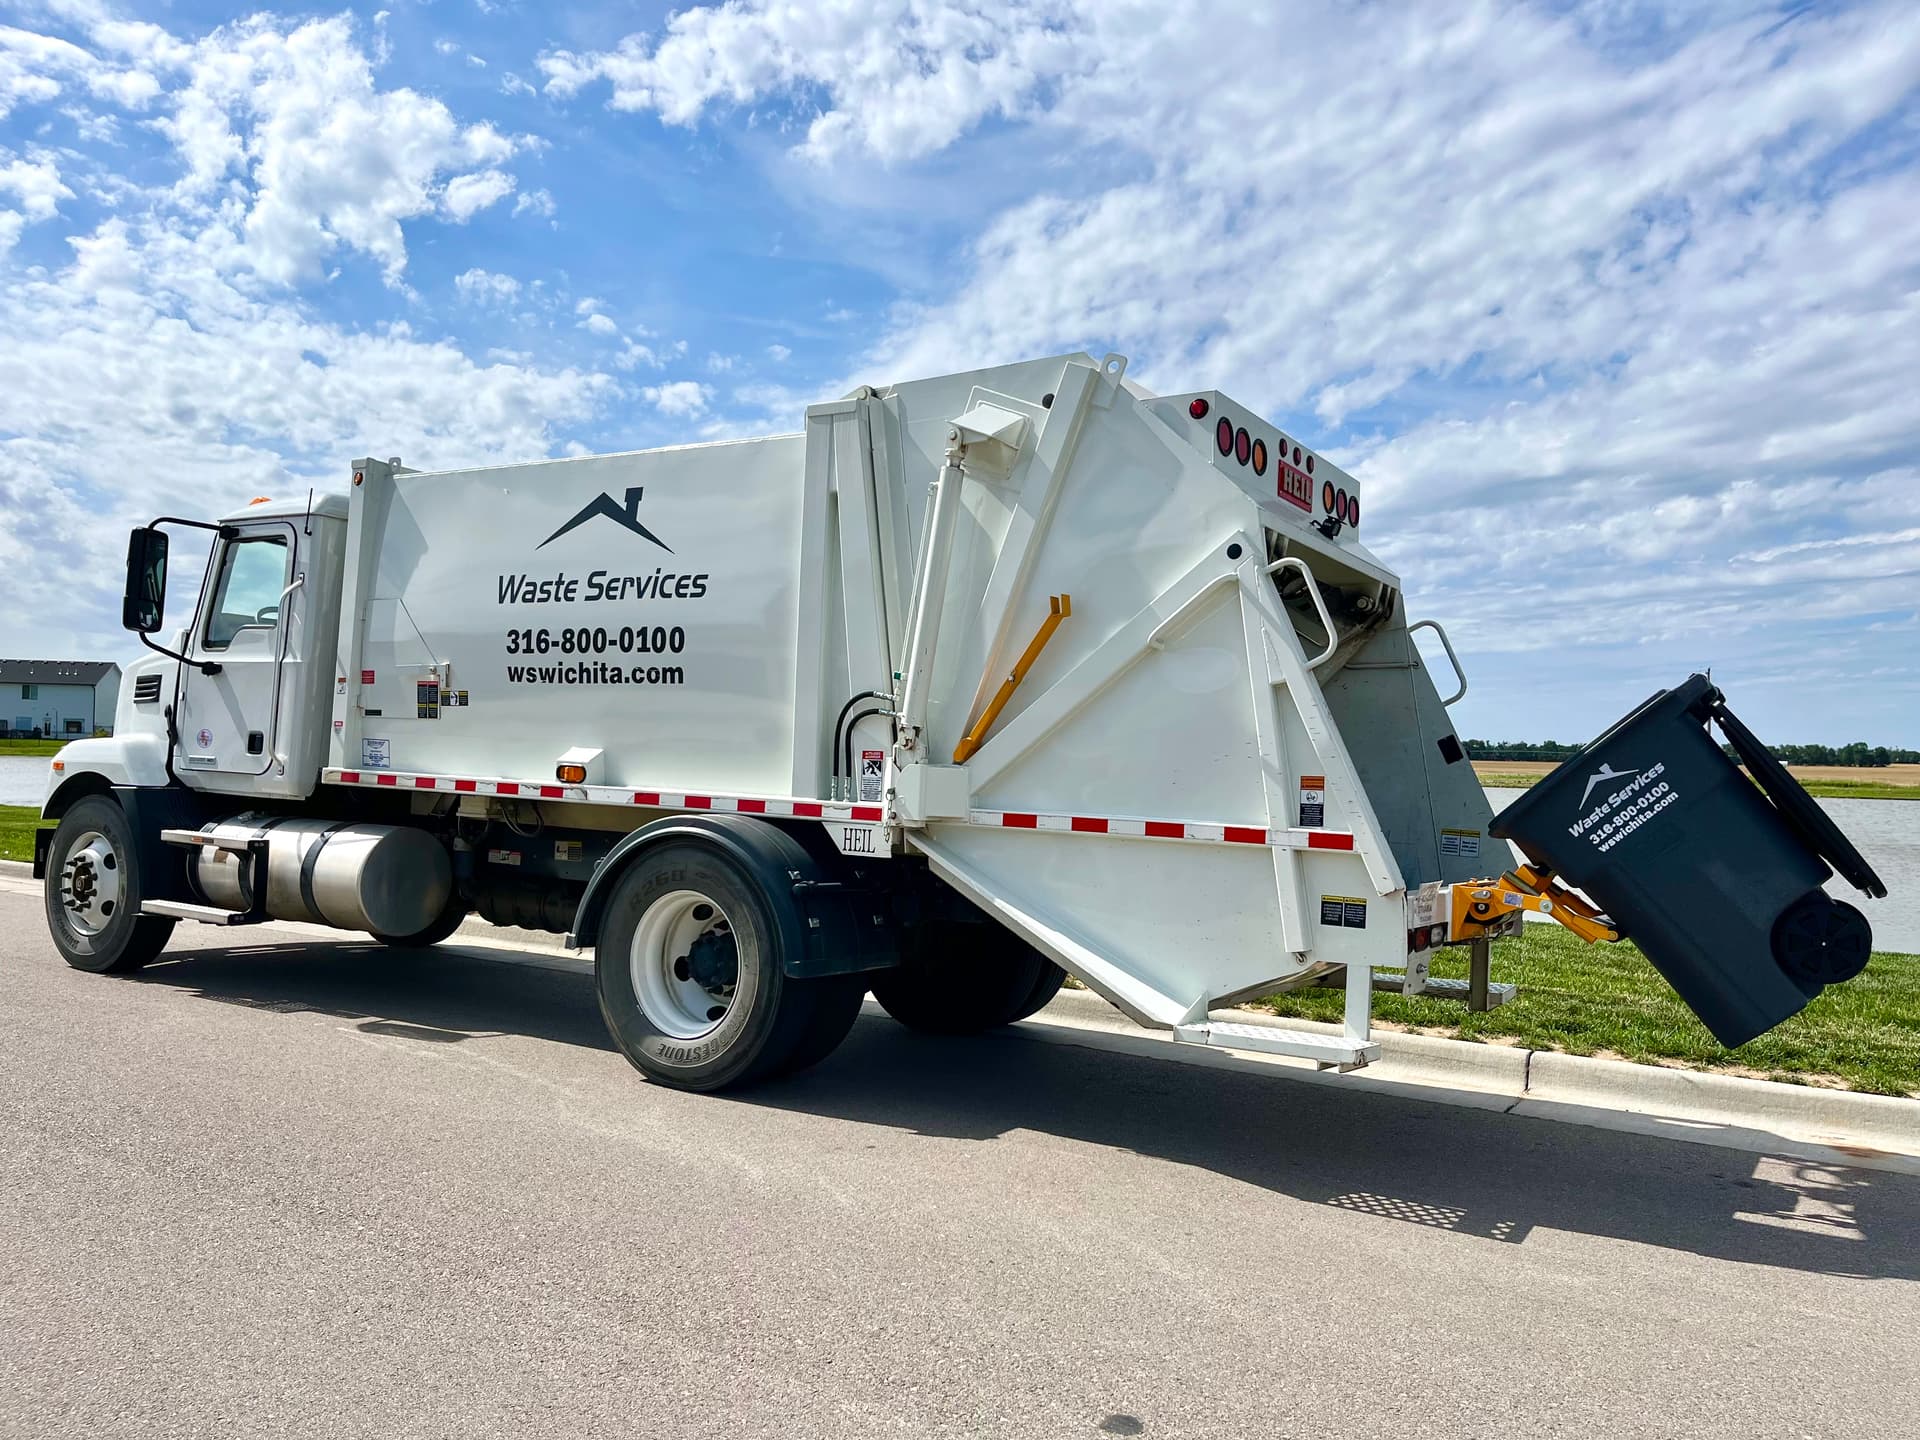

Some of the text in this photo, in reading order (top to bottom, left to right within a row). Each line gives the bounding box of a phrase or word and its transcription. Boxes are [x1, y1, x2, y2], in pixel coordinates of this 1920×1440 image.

[1284, 467, 1312, 504] HEIL
[498, 568, 709, 604] Waste Services
[506, 626, 685, 654] 316-800-0100
[507, 661, 684, 684] wswichita.com
[1568, 762, 1665, 837] Waste Services
[1589, 782, 1669, 844] 316-800-0100
[842, 827, 876, 854] HEIL
[1598, 792, 1679, 852] wswichita.com
[656, 1001, 750, 1063] DGESTONE
